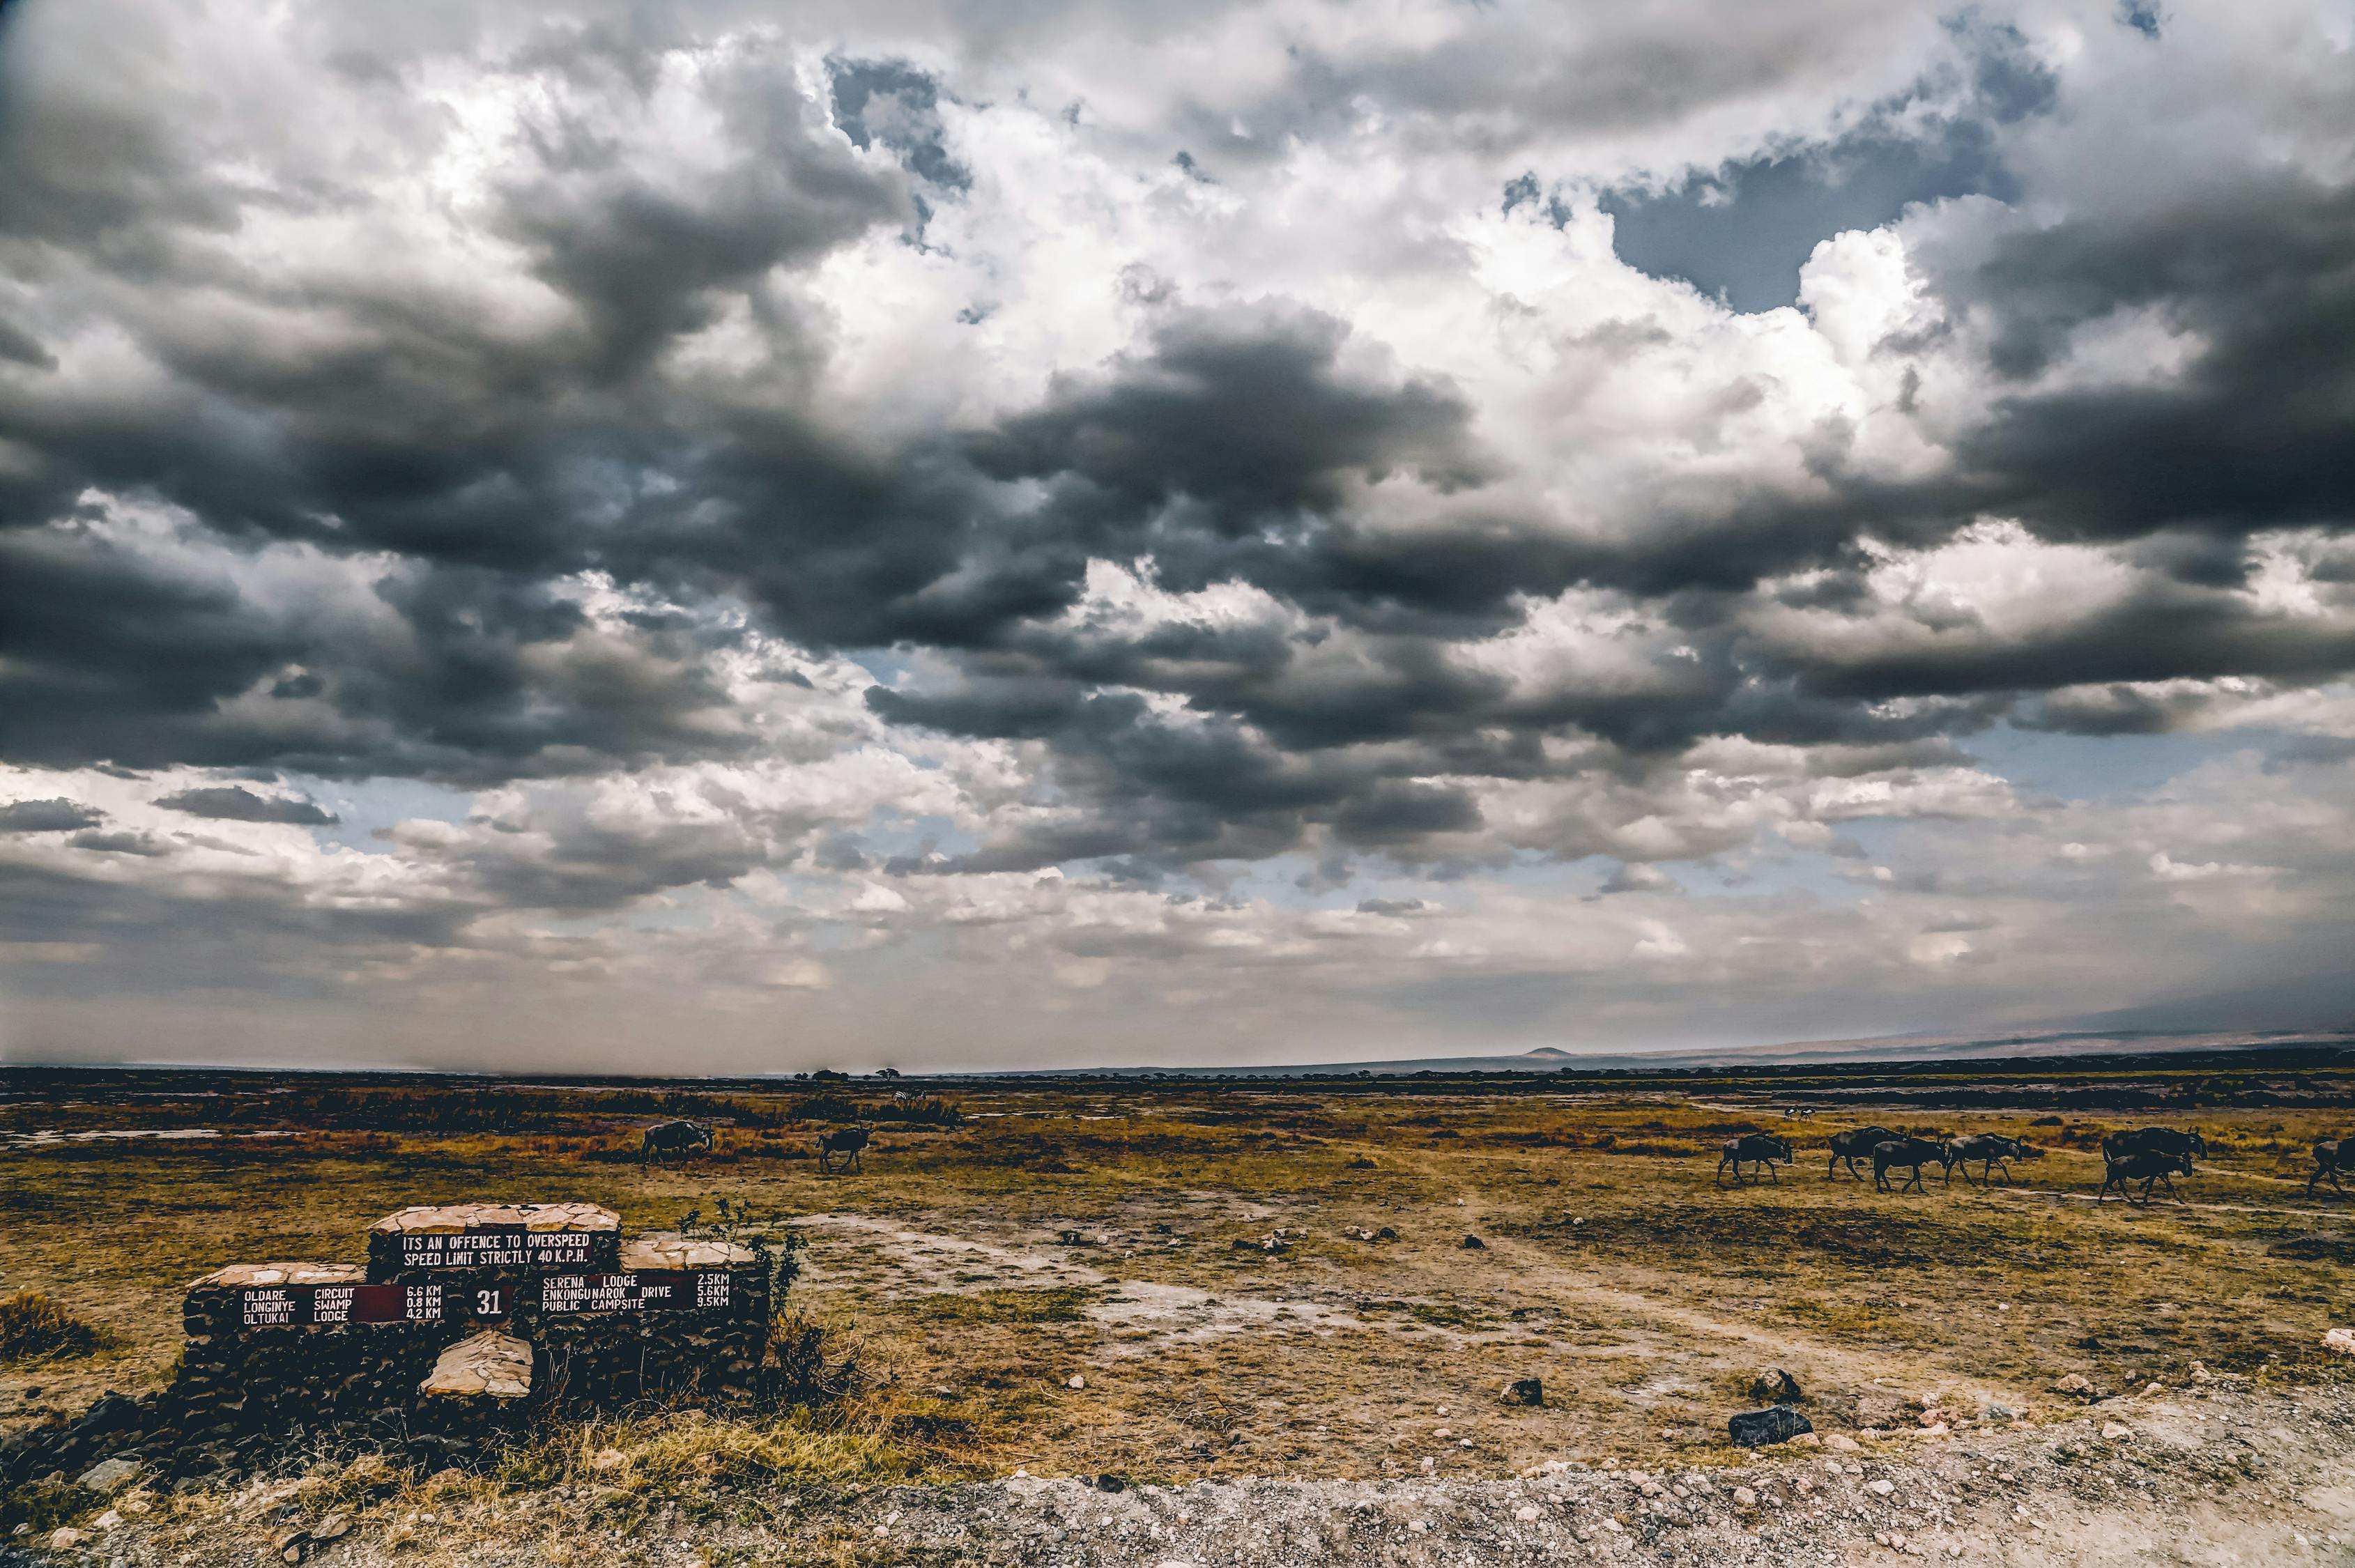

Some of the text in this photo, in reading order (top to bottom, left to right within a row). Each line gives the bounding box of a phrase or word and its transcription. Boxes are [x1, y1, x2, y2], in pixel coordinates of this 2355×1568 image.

[404, 1234, 590, 1250] ITS AN OFFENCE TO OVERSPEED
[404, 1252, 441, 1266] SPEED
[480, 1250, 532, 1264] STRICTLY
[538, 1250, 552, 1263] 40
[555, 1250, 588, 1262] K.P.H.
[544, 1273, 730, 1289] SERENA LODGE 2.5KM
[245, 1285, 441, 1301] OLDARE CIRCUIT 6.6 KM
[642, 1286, 671, 1298] DRIVE
[697, 1286, 729, 1296] 5.6KM
[244, 1296, 441, 1313] LONGINYE SWAMP 0.8 KM
[477, 1290, 502, 1314] 31
[542, 1297, 728, 1312] PUBLIC CAMPSITE 9.5KM
[244, 1307, 440, 1324] OLTUKAI LODGE 4.2 KM
